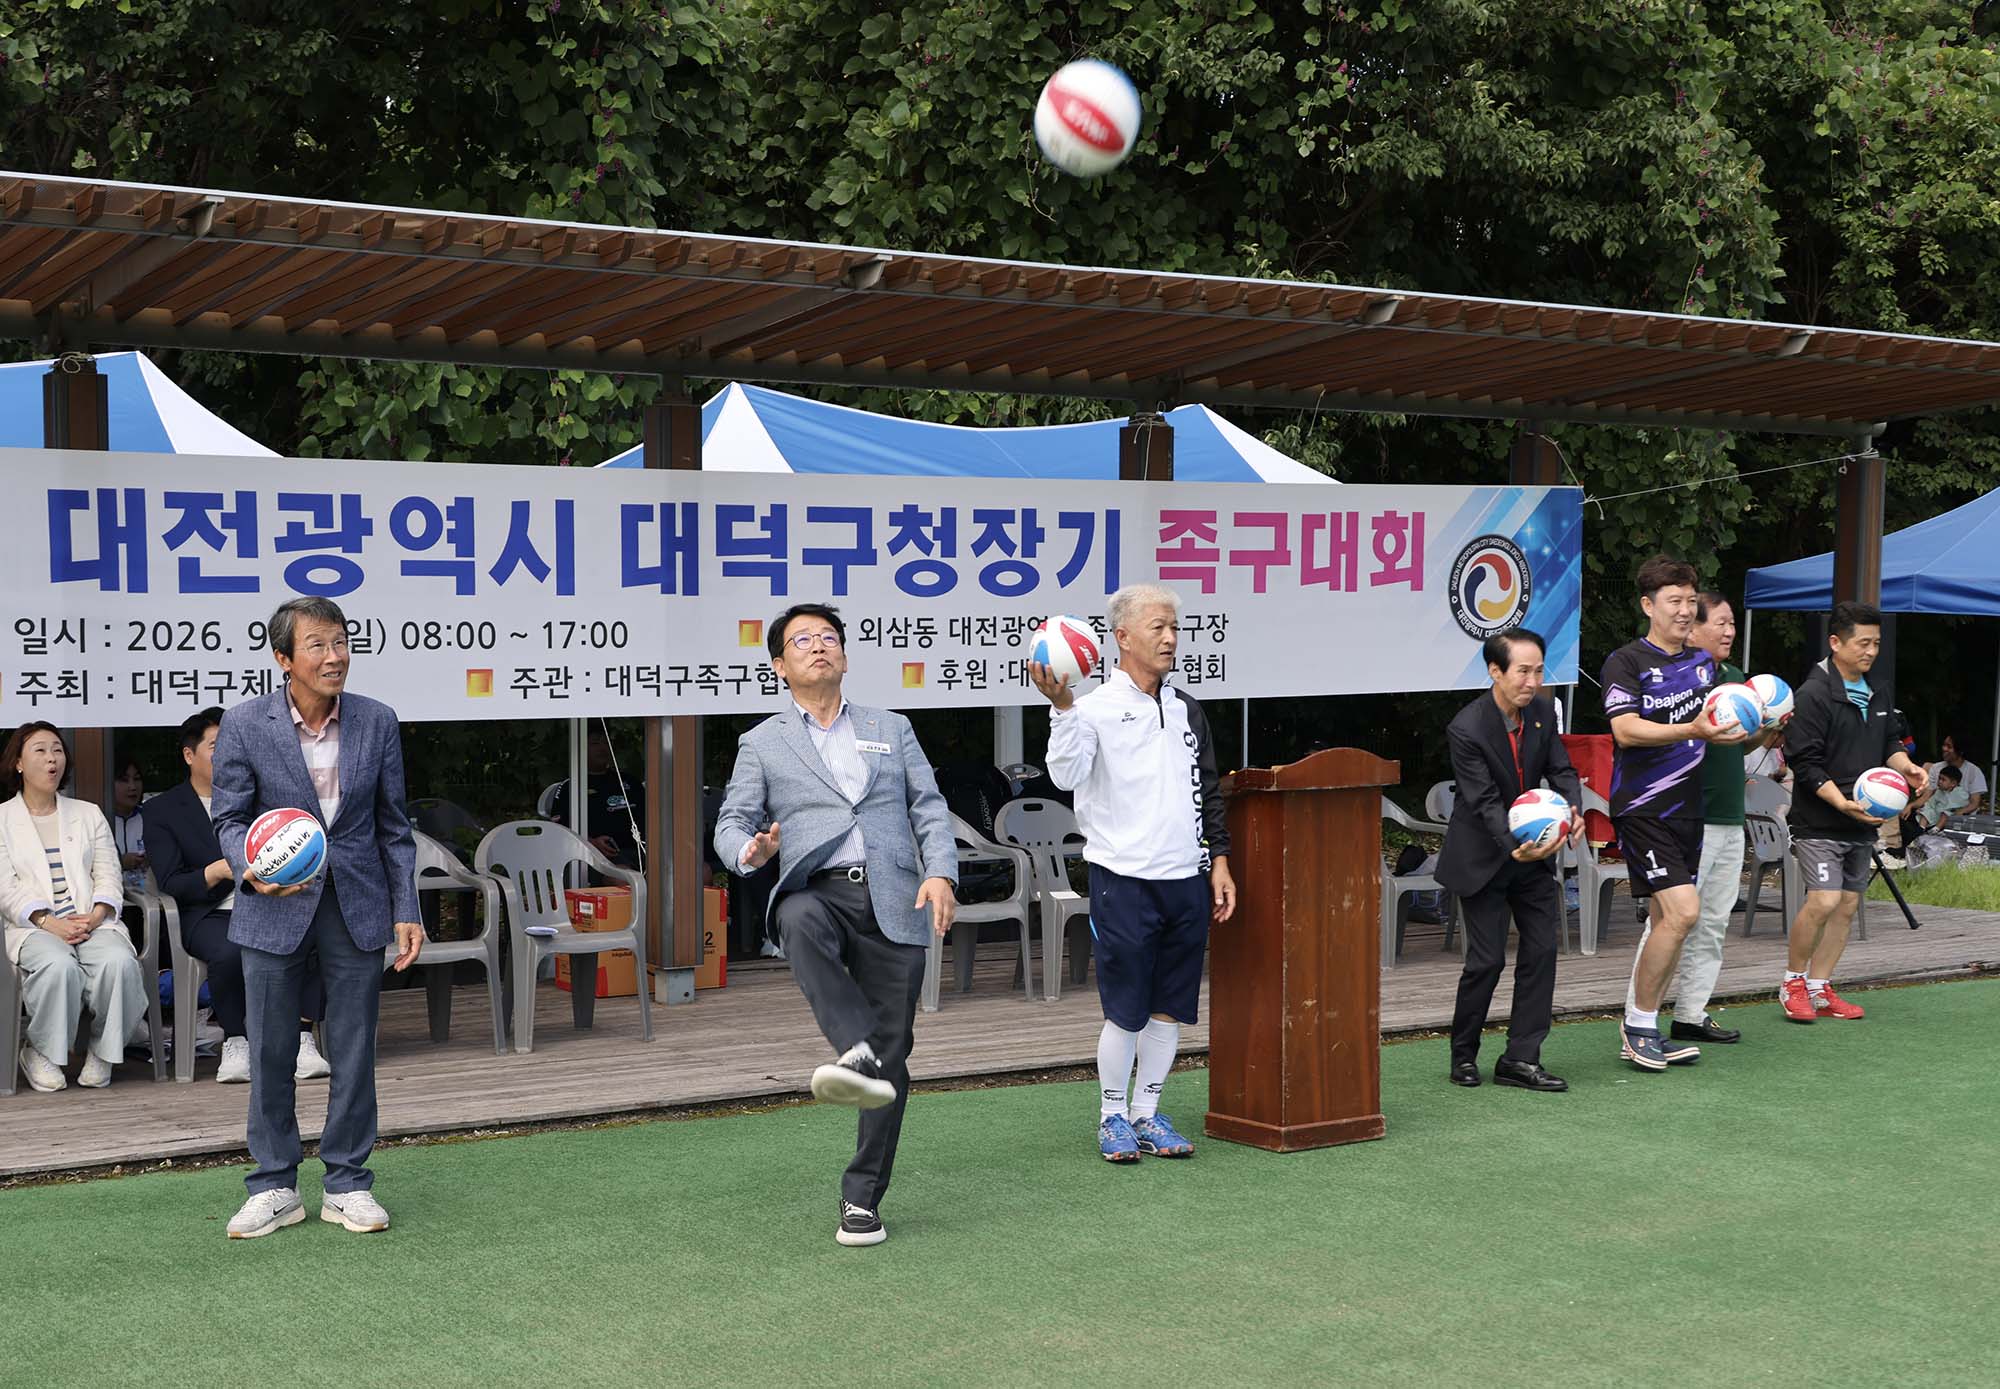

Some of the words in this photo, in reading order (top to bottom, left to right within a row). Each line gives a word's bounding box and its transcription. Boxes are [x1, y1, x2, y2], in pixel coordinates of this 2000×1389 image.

[47, 487, 576, 598] 대전광역시
[620, 501, 1121, 598] 대덕구청장기
[1155, 509, 1426, 594] 족구대회
[14, 617, 86, 655] 일시
[127, 620, 233, 653] 2026.
[400, 620, 496, 650] 08:00
[541, 620, 629, 650] 17:00
[858, 616, 938, 649] 외삼동
[15, 669, 89, 706] 주최
[131, 669, 290, 705] 대덕구체
[509, 665, 573, 700] 주관
[604, 662, 790, 698] 대덕구족구협
[937, 659, 988, 691] 후원
[1642, 688, 1693, 710] Deajeon
[1645, 849, 1659, 869] 1
[1817, 863, 1830, 883] 5
